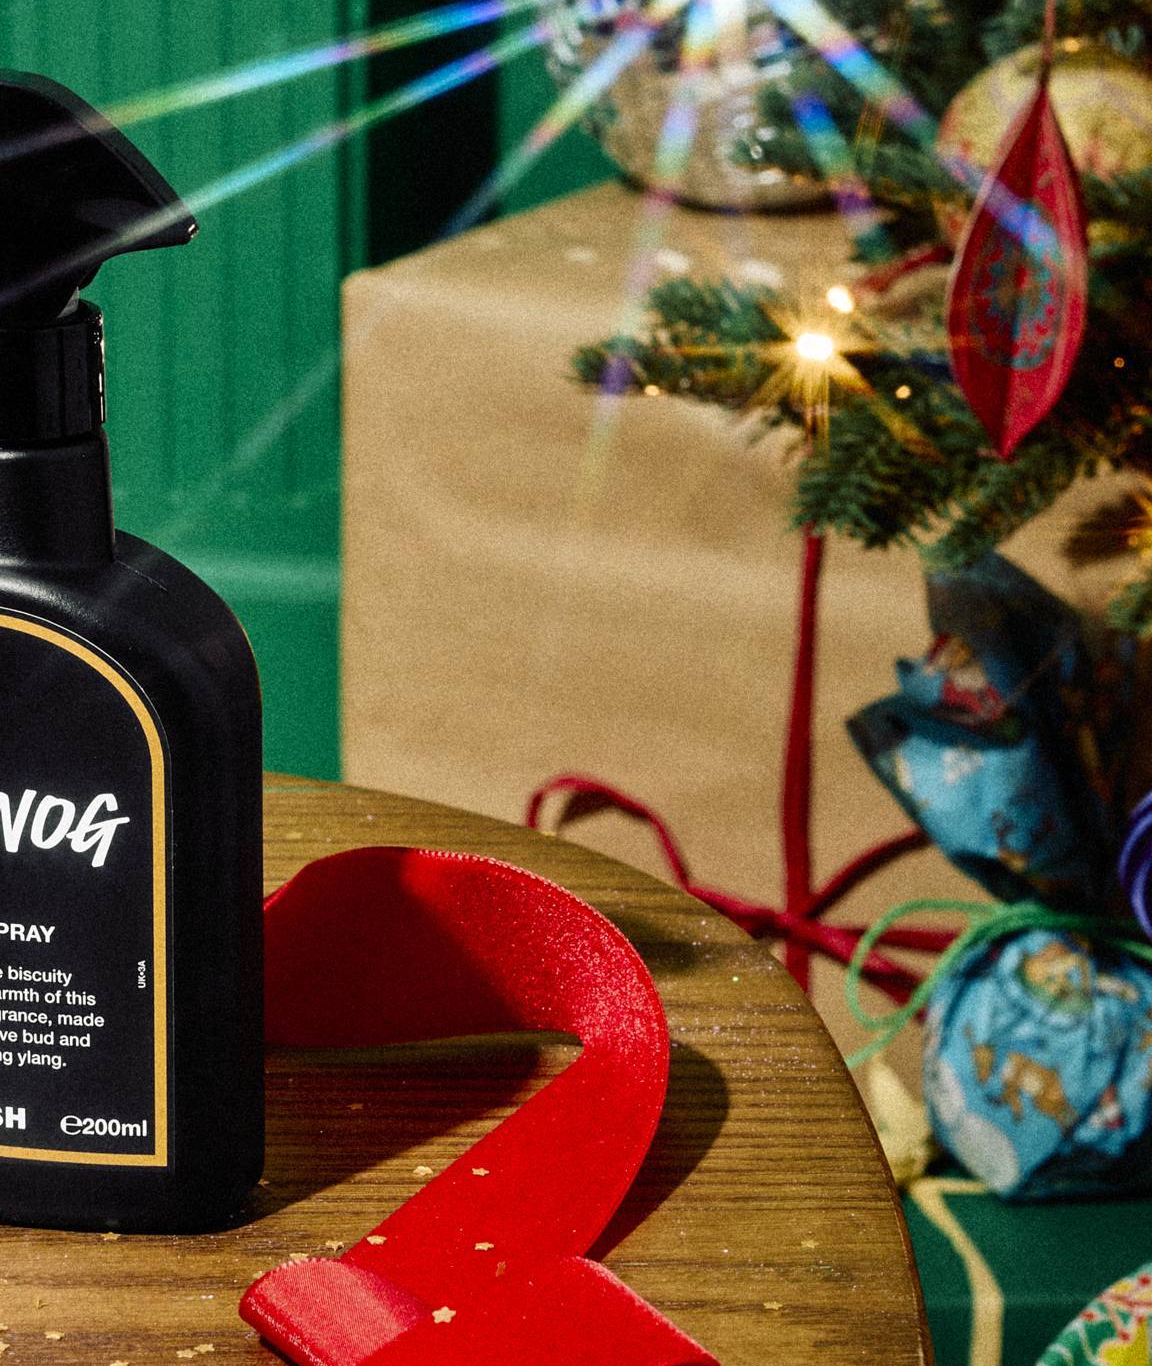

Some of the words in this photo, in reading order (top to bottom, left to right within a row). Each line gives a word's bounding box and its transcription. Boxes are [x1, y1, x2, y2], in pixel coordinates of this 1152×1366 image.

[7, 964, 73, 988] biscuity
[43, 989, 63, 1004] of
[64, 990, 97, 1007] this
[57, 1012, 105, 1028] made
[22, 1028, 55, 1046] bud
[58, 1032, 91, 1048] and
[16, 1049, 68, 1071] ylang.
